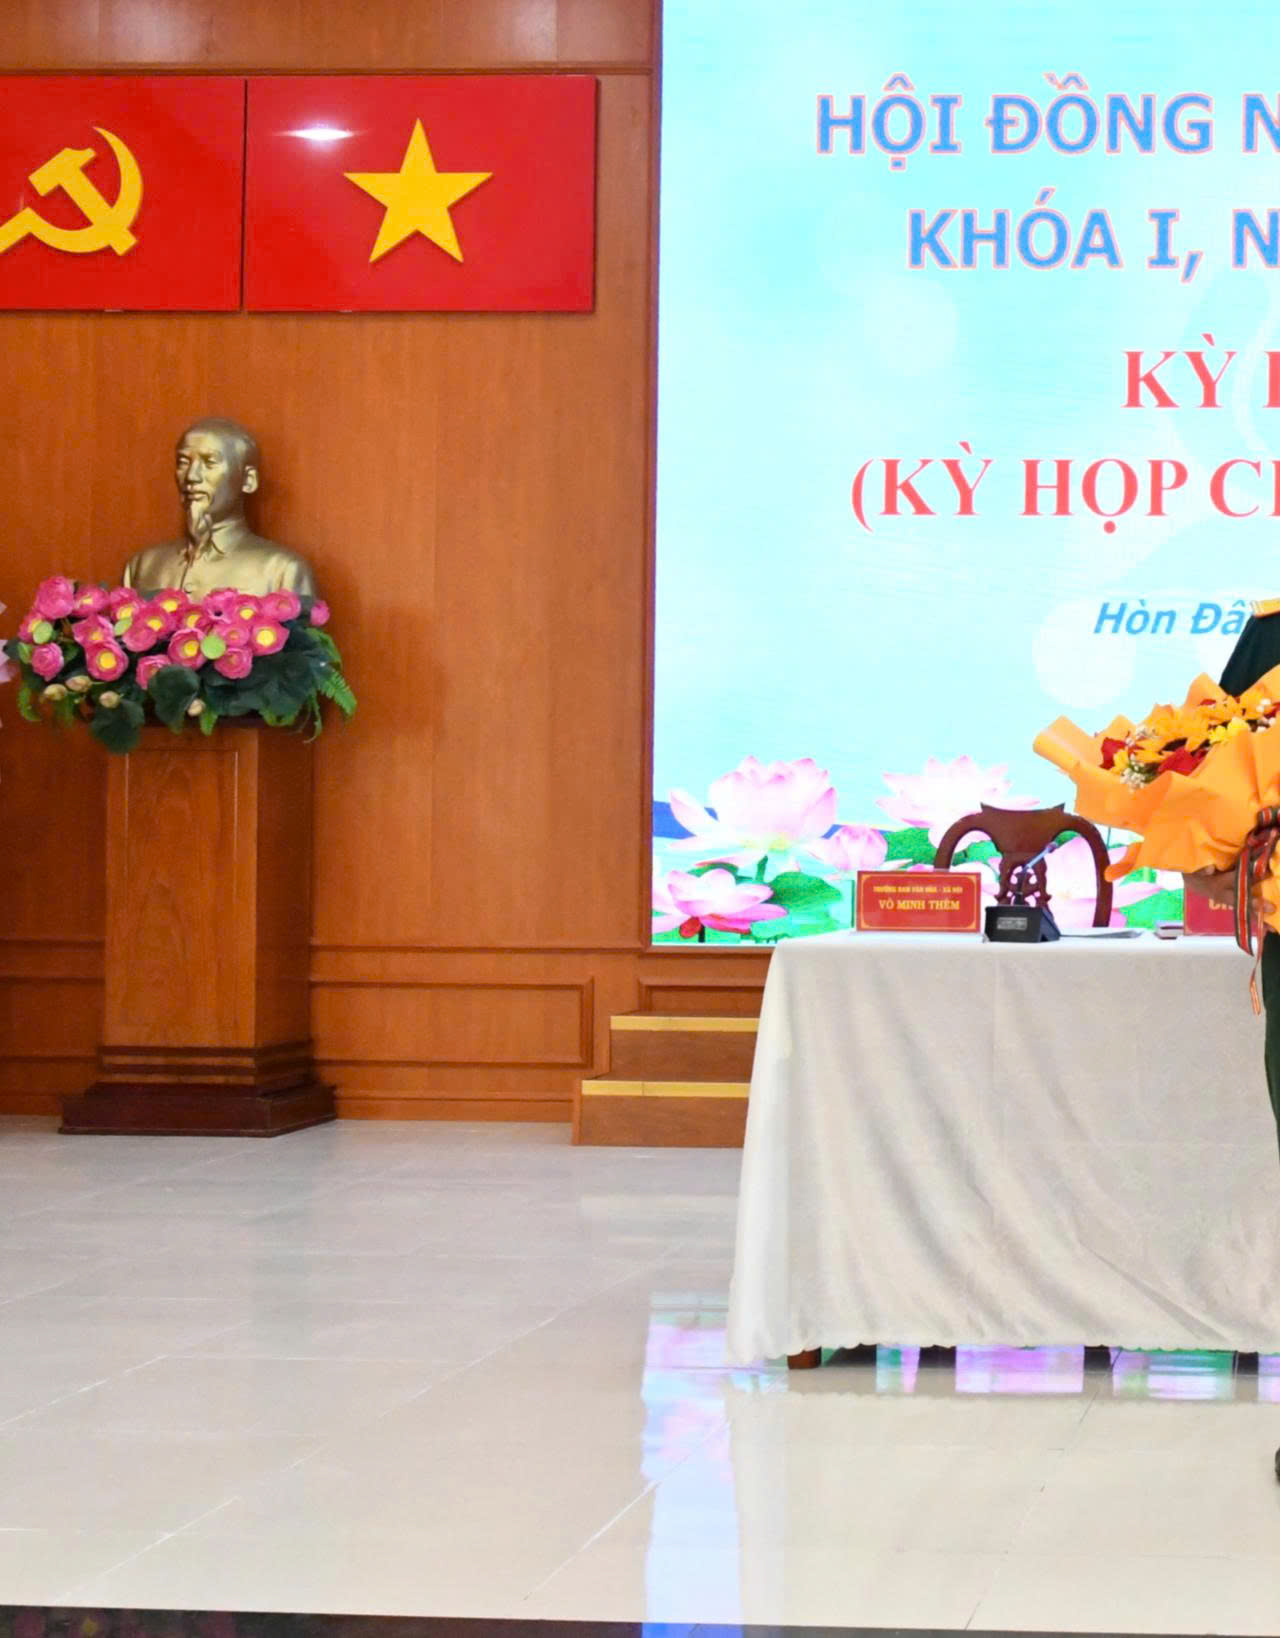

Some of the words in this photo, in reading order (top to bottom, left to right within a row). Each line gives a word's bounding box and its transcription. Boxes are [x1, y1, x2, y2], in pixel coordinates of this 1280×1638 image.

[816, 73, 964, 172] HỘI
[985, 72, 1216, 156] ĐỒNG
[908, 188, 1125, 270] KHÓA
[1147, 208, 1205, 285] I,
[1123, 333, 1237, 410] KỲ
[850, 441, 994, 533] (KỲ
[1020, 458, 1190, 535] HỌP
[1094, 599, 1178, 636] Hòn
[896, 899, 926, 911] MINH
